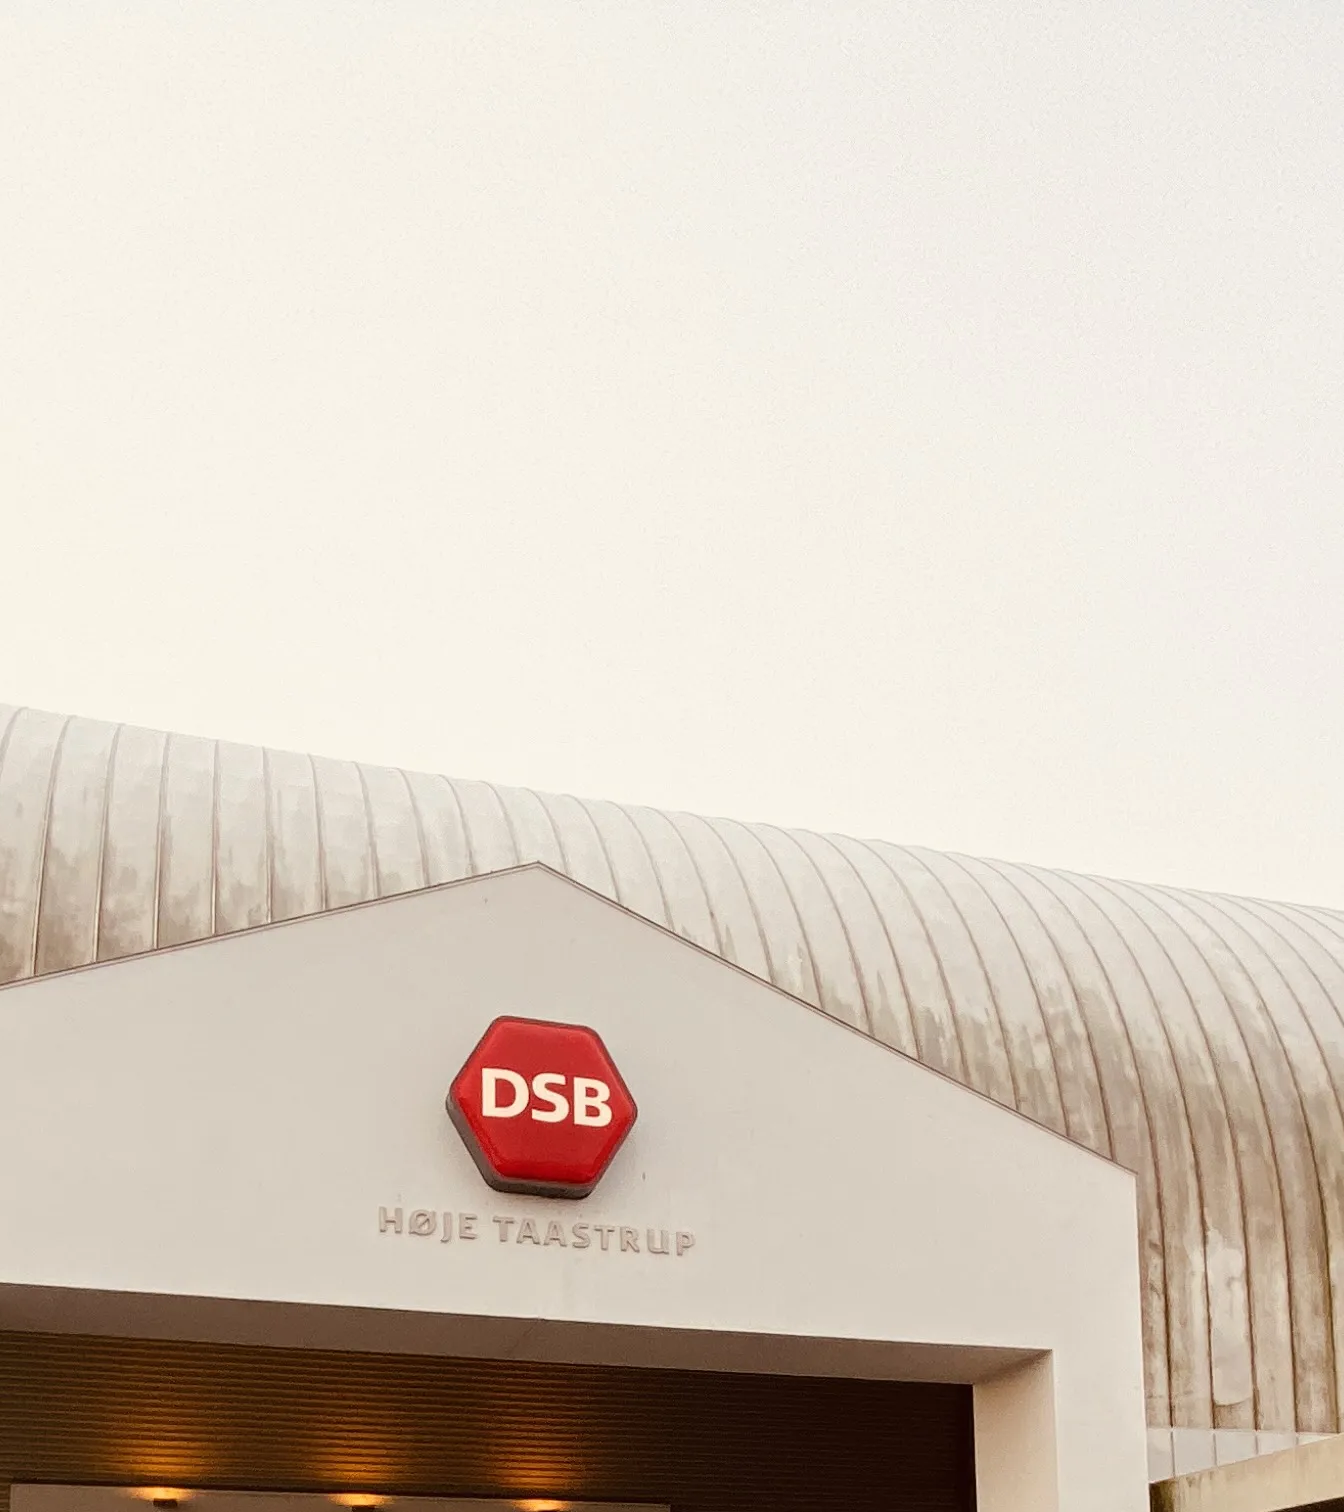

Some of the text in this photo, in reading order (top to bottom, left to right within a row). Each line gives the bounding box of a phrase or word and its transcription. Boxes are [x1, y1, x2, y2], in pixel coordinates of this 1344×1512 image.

[481, 1067, 613, 1128] DSB
[378, 1206, 695, 1257] HØJE TAASTRUP
